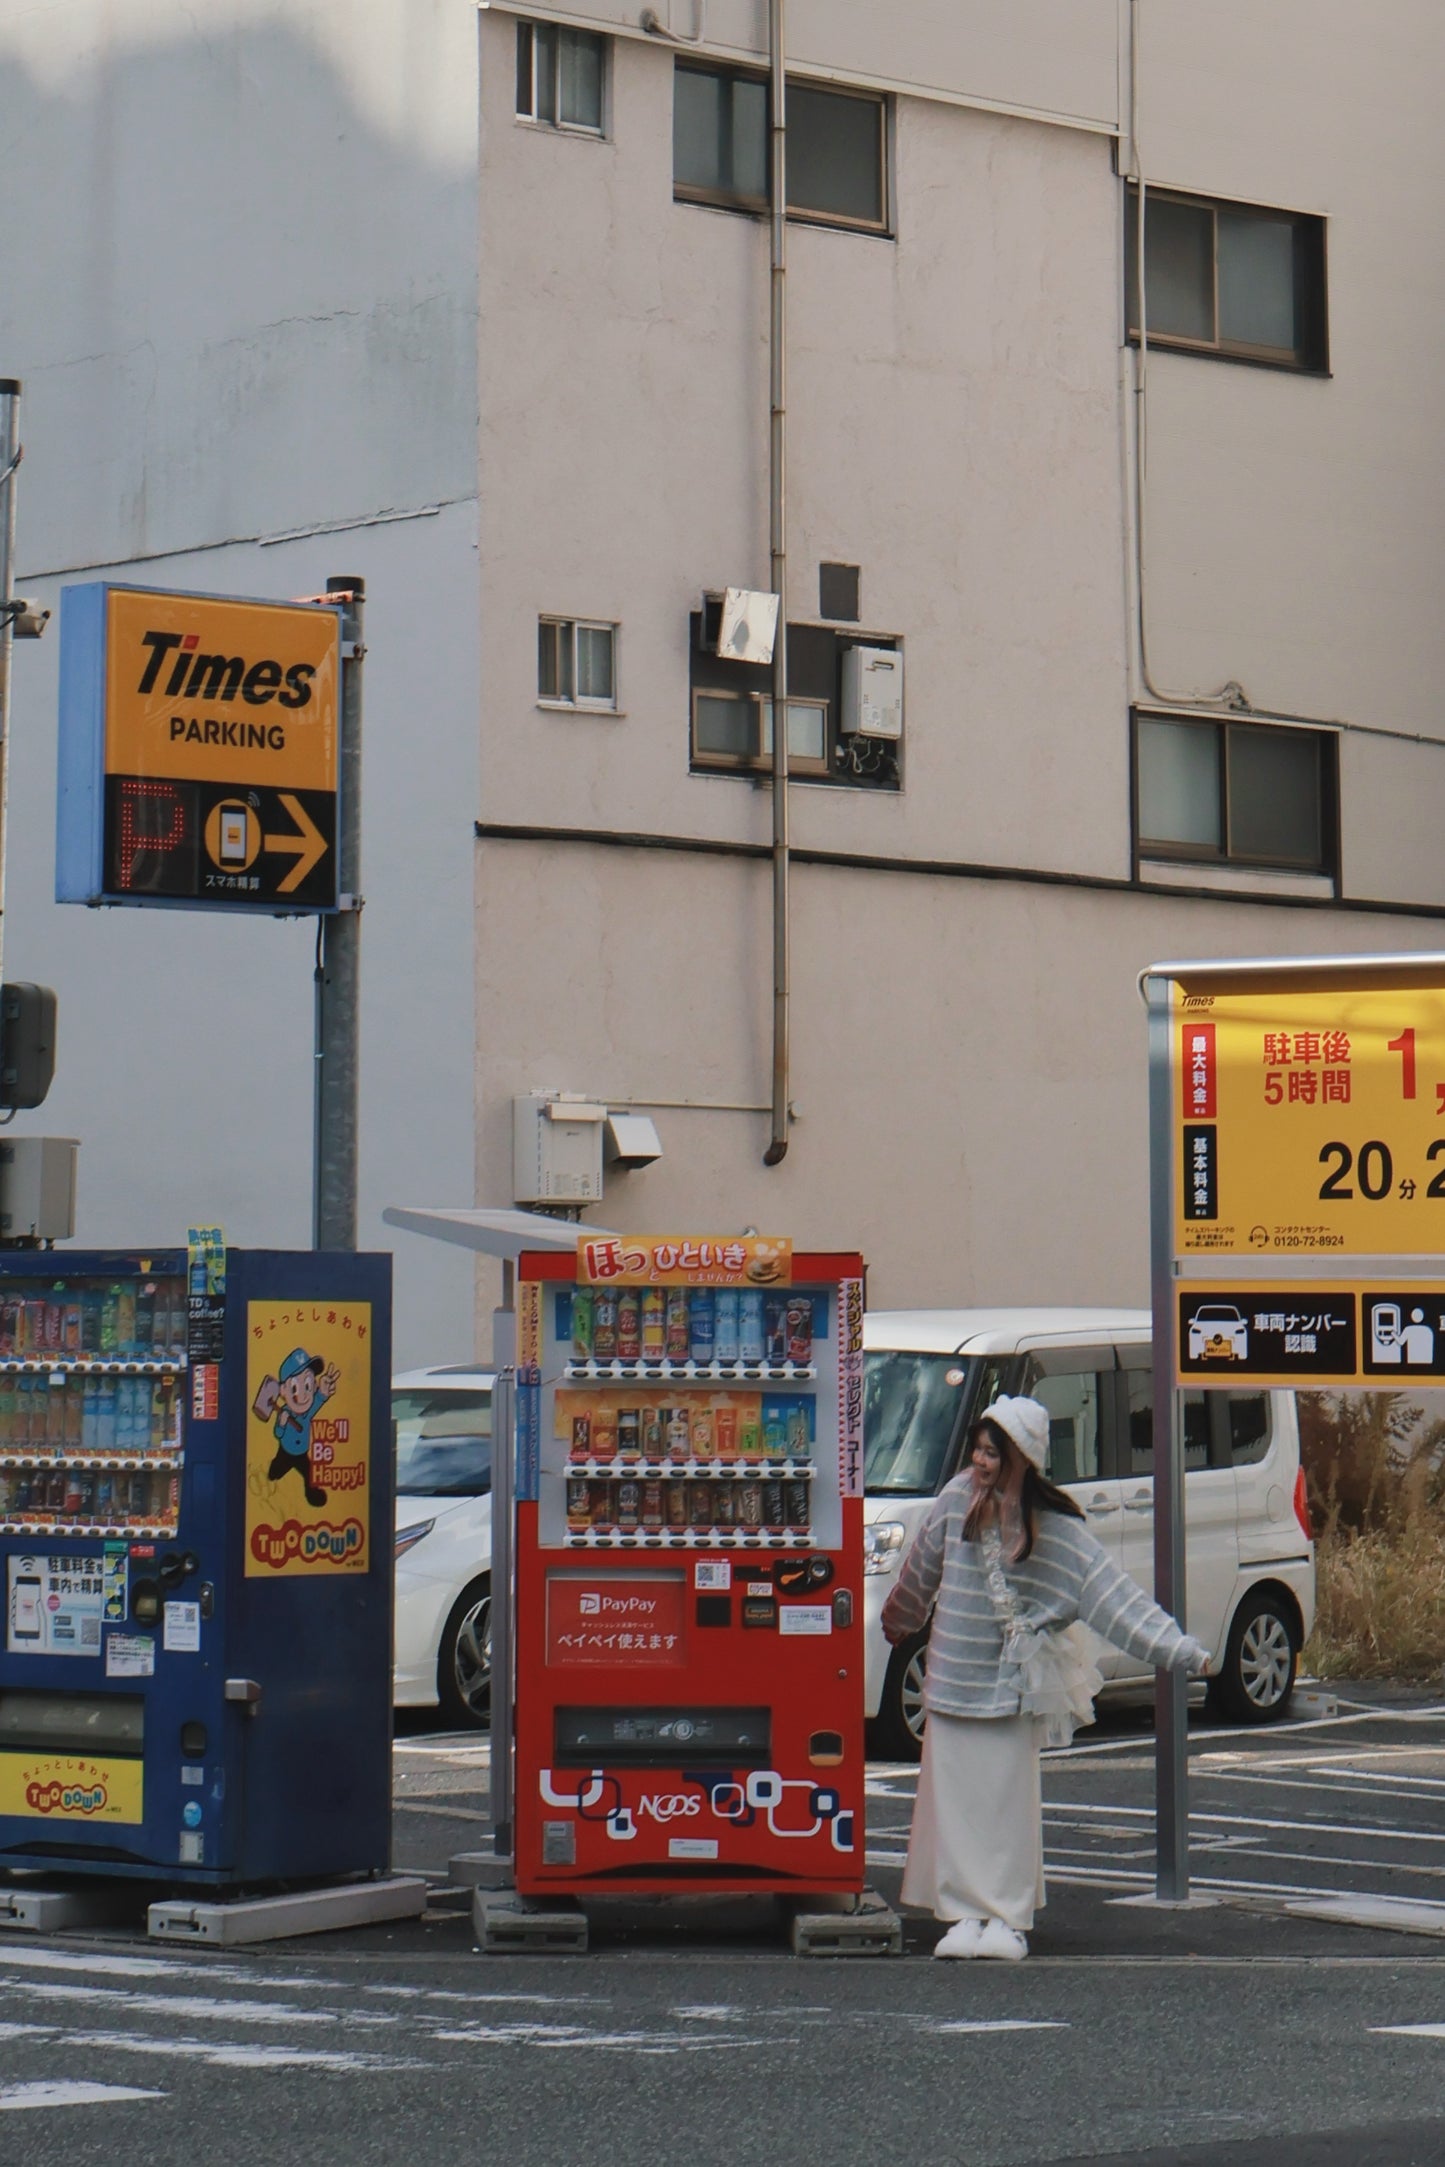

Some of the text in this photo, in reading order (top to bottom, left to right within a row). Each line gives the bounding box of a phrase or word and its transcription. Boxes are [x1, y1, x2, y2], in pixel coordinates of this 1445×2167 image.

[137, 631, 316, 709] Times
[169, 717, 285, 750] PARKING
[204, 874, 260, 891] スマホ精算
[1181, 994, 1216, 1007] Times
[1263, 1030, 1352, 1066] 駐車後
[1192, 1036, 1207, 1104] 最大料金
[1264, 1069, 1352, 1105] 5時間
[1193, 1137, 1208, 1206] 基本料金
[1274, 1226, 1331, 1234] コンタクトセンター
[1274, 1235, 1344, 1247] 0120-72-8924
[252, 1307, 368, 1339] ちょっとしあわせ
[1253, 1313, 1347, 1332] 車両ナンバー
[1284, 1334, 1318, 1354] 認識
[312, 1420, 348, 1440] We'll
[312, 1443, 333, 1461] Be
[312, 1464, 364, 1488] Happy!
[847, 1440, 860, 1490] コーナー
[257, 1527, 357, 1560] TWO DOWN
[602, 1595, 656, 1614] PayPay
[557, 1632, 679, 1650] ペイペイ使えます
[22, 1758, 110, 1782] ちょっとしあわせ
[30, 1787, 102, 1809] TWO DOWN
